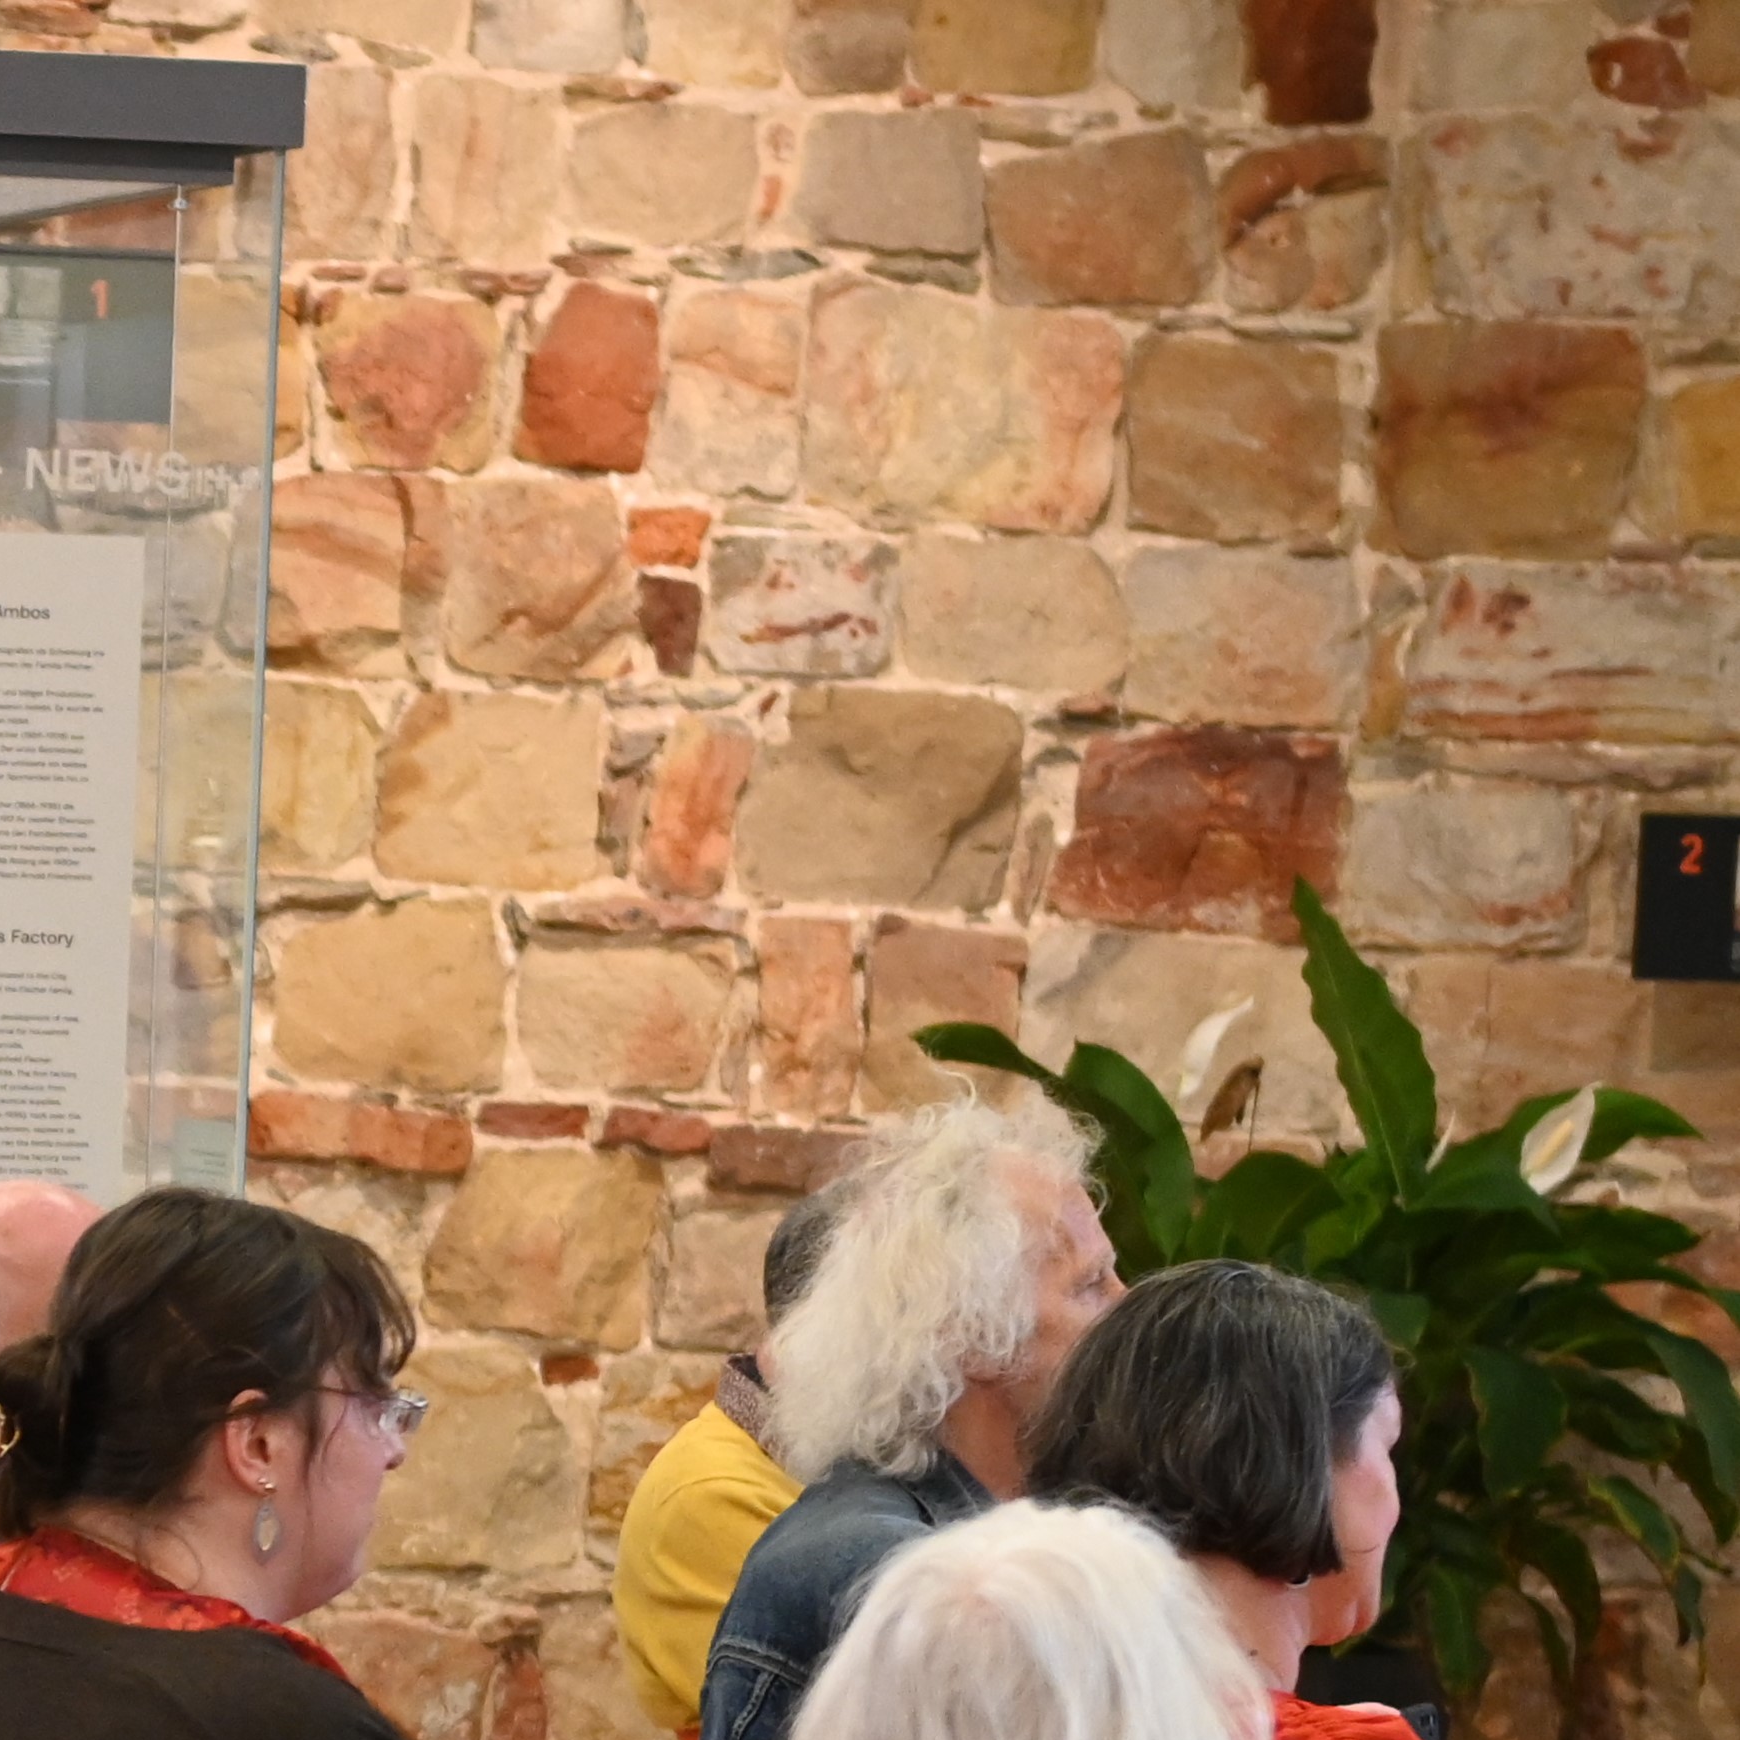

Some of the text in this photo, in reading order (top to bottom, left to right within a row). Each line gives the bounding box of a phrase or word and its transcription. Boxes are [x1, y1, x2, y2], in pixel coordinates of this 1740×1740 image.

[90, 279, 108, 320] 1
[25, 447, 190, 499] NEWS
[1680, 833, 1704, 875] 2
[10, 929, 74, 948] Factory
